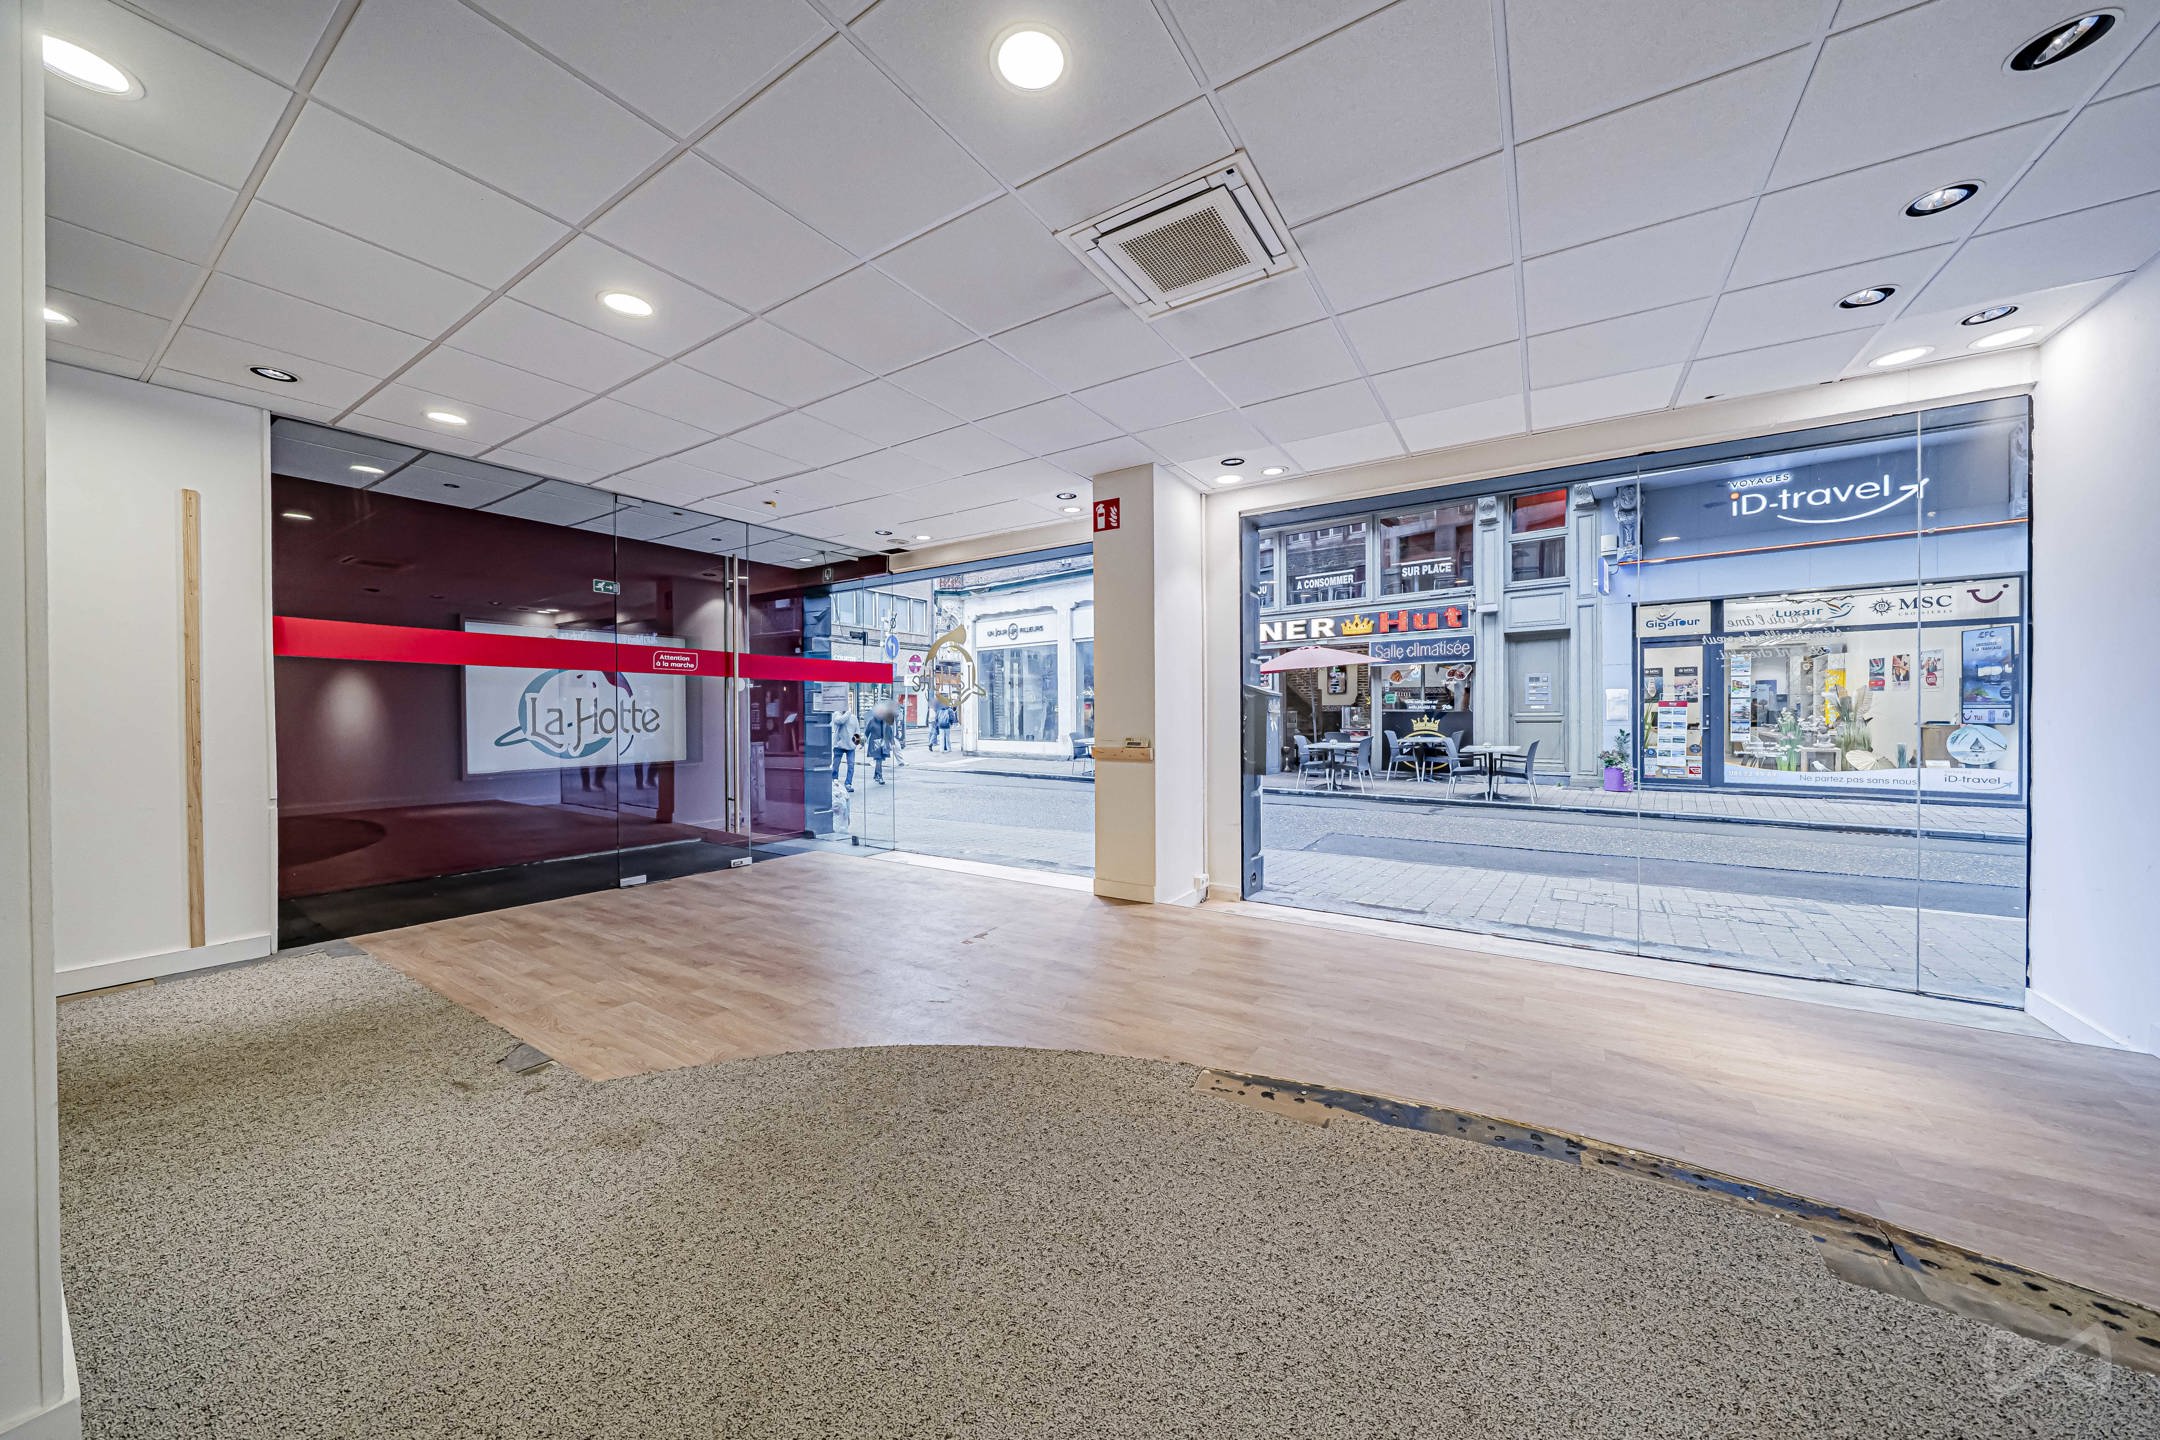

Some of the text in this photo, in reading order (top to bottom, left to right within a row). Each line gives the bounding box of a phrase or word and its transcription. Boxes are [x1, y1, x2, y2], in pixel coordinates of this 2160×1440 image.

[1730, 473, 1790, 488] VOYAGES
[1730, 474, 1890, 517] iD-travel
[1402, 561, 1452, 577] SUR PLACE
[1296, 574, 1354, 590] A CONSOMMER
[1899, 594, 1953, 610] MSC
[1378, 606, 1463, 633] Hut
[1776, 606, 1823, 618] Luxair
[1645, 617, 1701, 631] GigaTour
[1375, 640, 1471, 660] Salle climatisée
[1799, 774, 1812, 782] Ne
[1814, 775, 1845, 784] partez
[1866, 777, 1890, 785] sans
[1944, 774, 2001, 785] iD-travel
